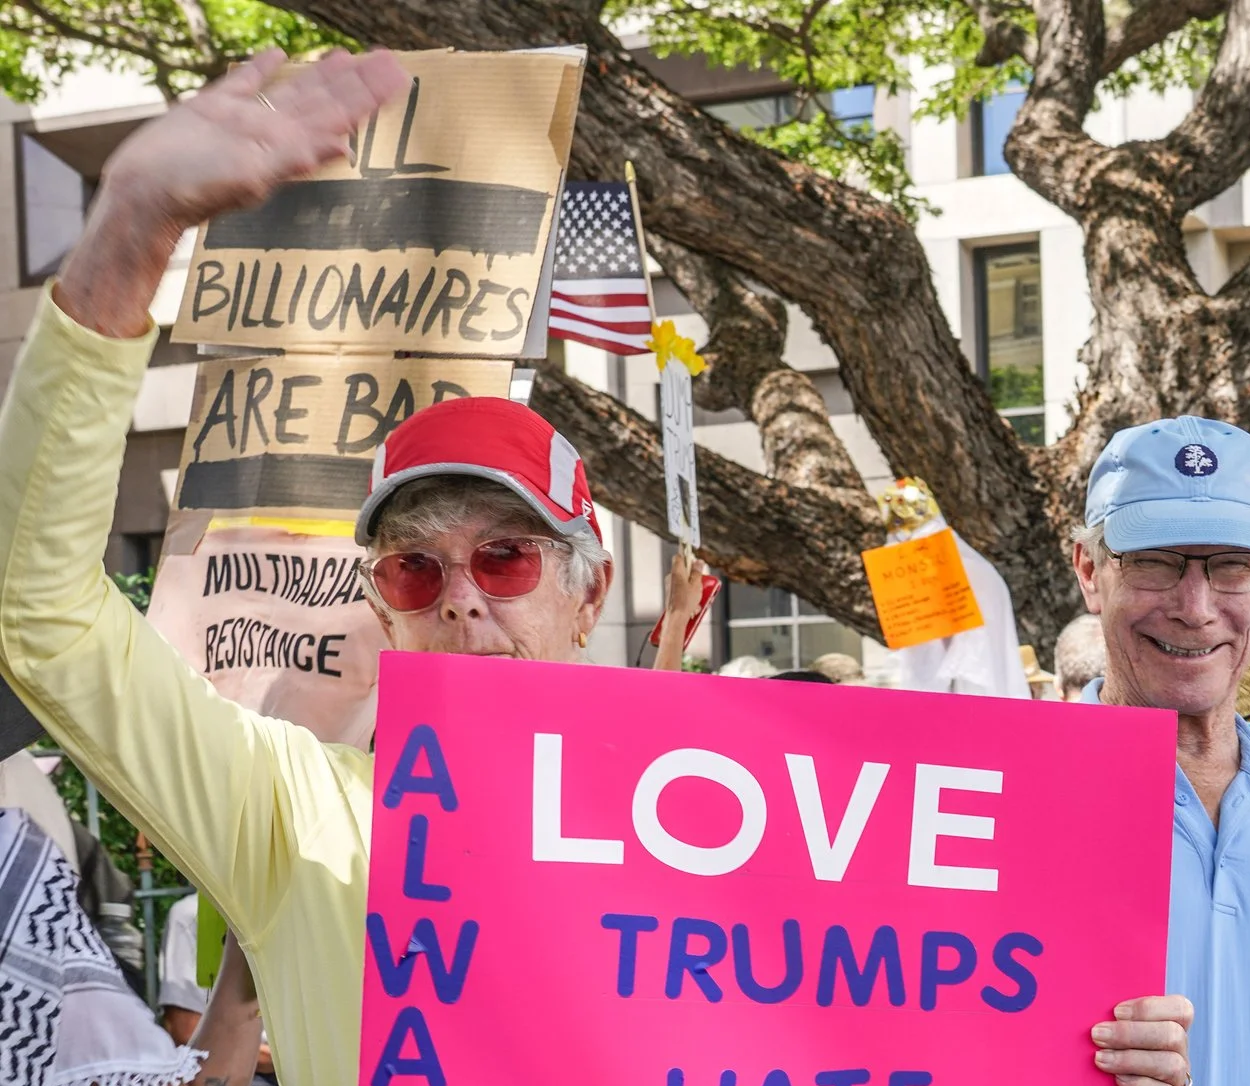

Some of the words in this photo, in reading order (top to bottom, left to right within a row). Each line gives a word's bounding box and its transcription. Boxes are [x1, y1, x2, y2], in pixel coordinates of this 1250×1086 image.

[349, 76, 450, 179] LL
[191, 259, 531, 343] BILLIONAIRES
[193, 367, 323, 456] ARE
[333, 372, 471, 454] BA
[204, 616, 347, 678] RESISTANCE
[531, 733, 1004, 892] LOVE
[601, 912, 1044, 1014] TRUMPS
